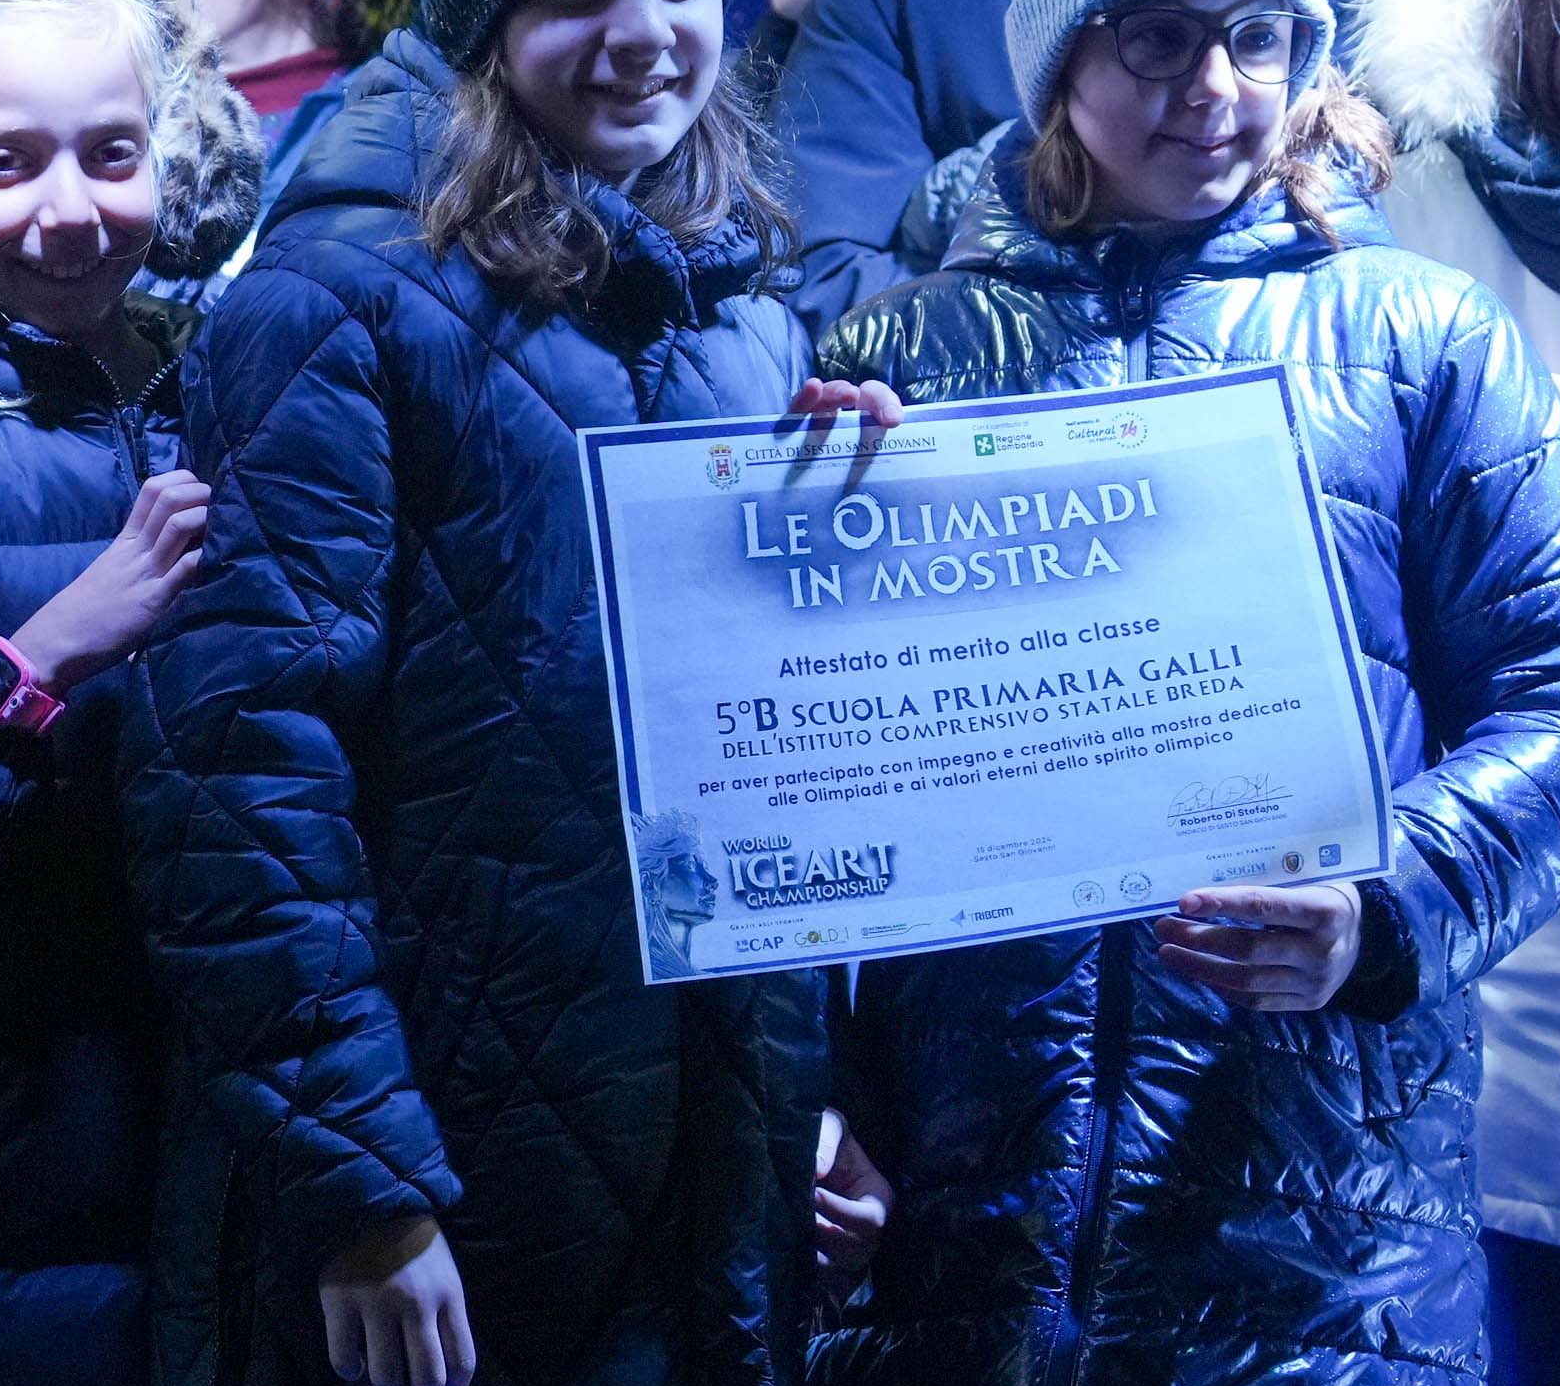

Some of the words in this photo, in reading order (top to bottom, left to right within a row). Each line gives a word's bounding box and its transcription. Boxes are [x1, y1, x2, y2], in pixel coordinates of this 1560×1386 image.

[873, 436, 936, 452] GIOVANNI
[995, 433, 1033, 446] Regione
[996, 438, 1044, 452] Lombardia
[1067, 426, 1116, 441] Cultural
[740, 500, 812, 559] LE
[832, 478, 1159, 551] OLIMPIADI
[787, 564, 844, 608] IN
[868, 536, 1122, 603] MOSTRA
[779, 650, 888, 678] Attestato
[897, 644, 920, 666] di
[929, 636, 1010, 663] merito
[1019, 629, 1068, 653] alla
[1077, 617, 1161, 644] classe
[792, 694, 920, 728] SCUOLA
[932, 666, 1126, 714] PRIMARIA
[1139, 644, 1244, 682] GALLI
[722, 729, 872, 760] DELL'ISTITUTO
[880, 707, 1049, 743] COMPRENSIVO
[1058, 689, 1158, 720] STATALE
[1166, 676, 1245, 702] BREDA
[698, 780, 726, 797] per
[731, 776, 769, 792] aver
[775, 764, 875, 788] partecipato
[880, 761, 913, 775] con
[919, 749, 997, 771] impegno
[1003, 747, 1015, 759] e
[1020, 730, 1106, 758] creatività
[1111, 725, 1145, 742] alla
[1151, 713, 1213, 736] mostra
[1218, 696, 1302, 723] dedicata
[768, 792, 799, 807] alle
[804, 779, 889, 803] Olimpiadi
[893, 781, 904, 793] e
[910, 776, 927, 792] ai
[932, 770, 981, 788] valori
[987, 762, 1038, 781] eterni
[1043, 755, 1088, 774] dello
[1094, 744, 1149, 766] spirito
[1154, 729, 1234, 755] olimpico
[1180, 813, 1223, 827] Roberto
[1224, 808, 1236, 819] Di
[1237, 803, 1280, 818] Stefano
[722, 833, 792, 855] WORLD
[746, 877, 889, 909] CHAMPIONSHIP
